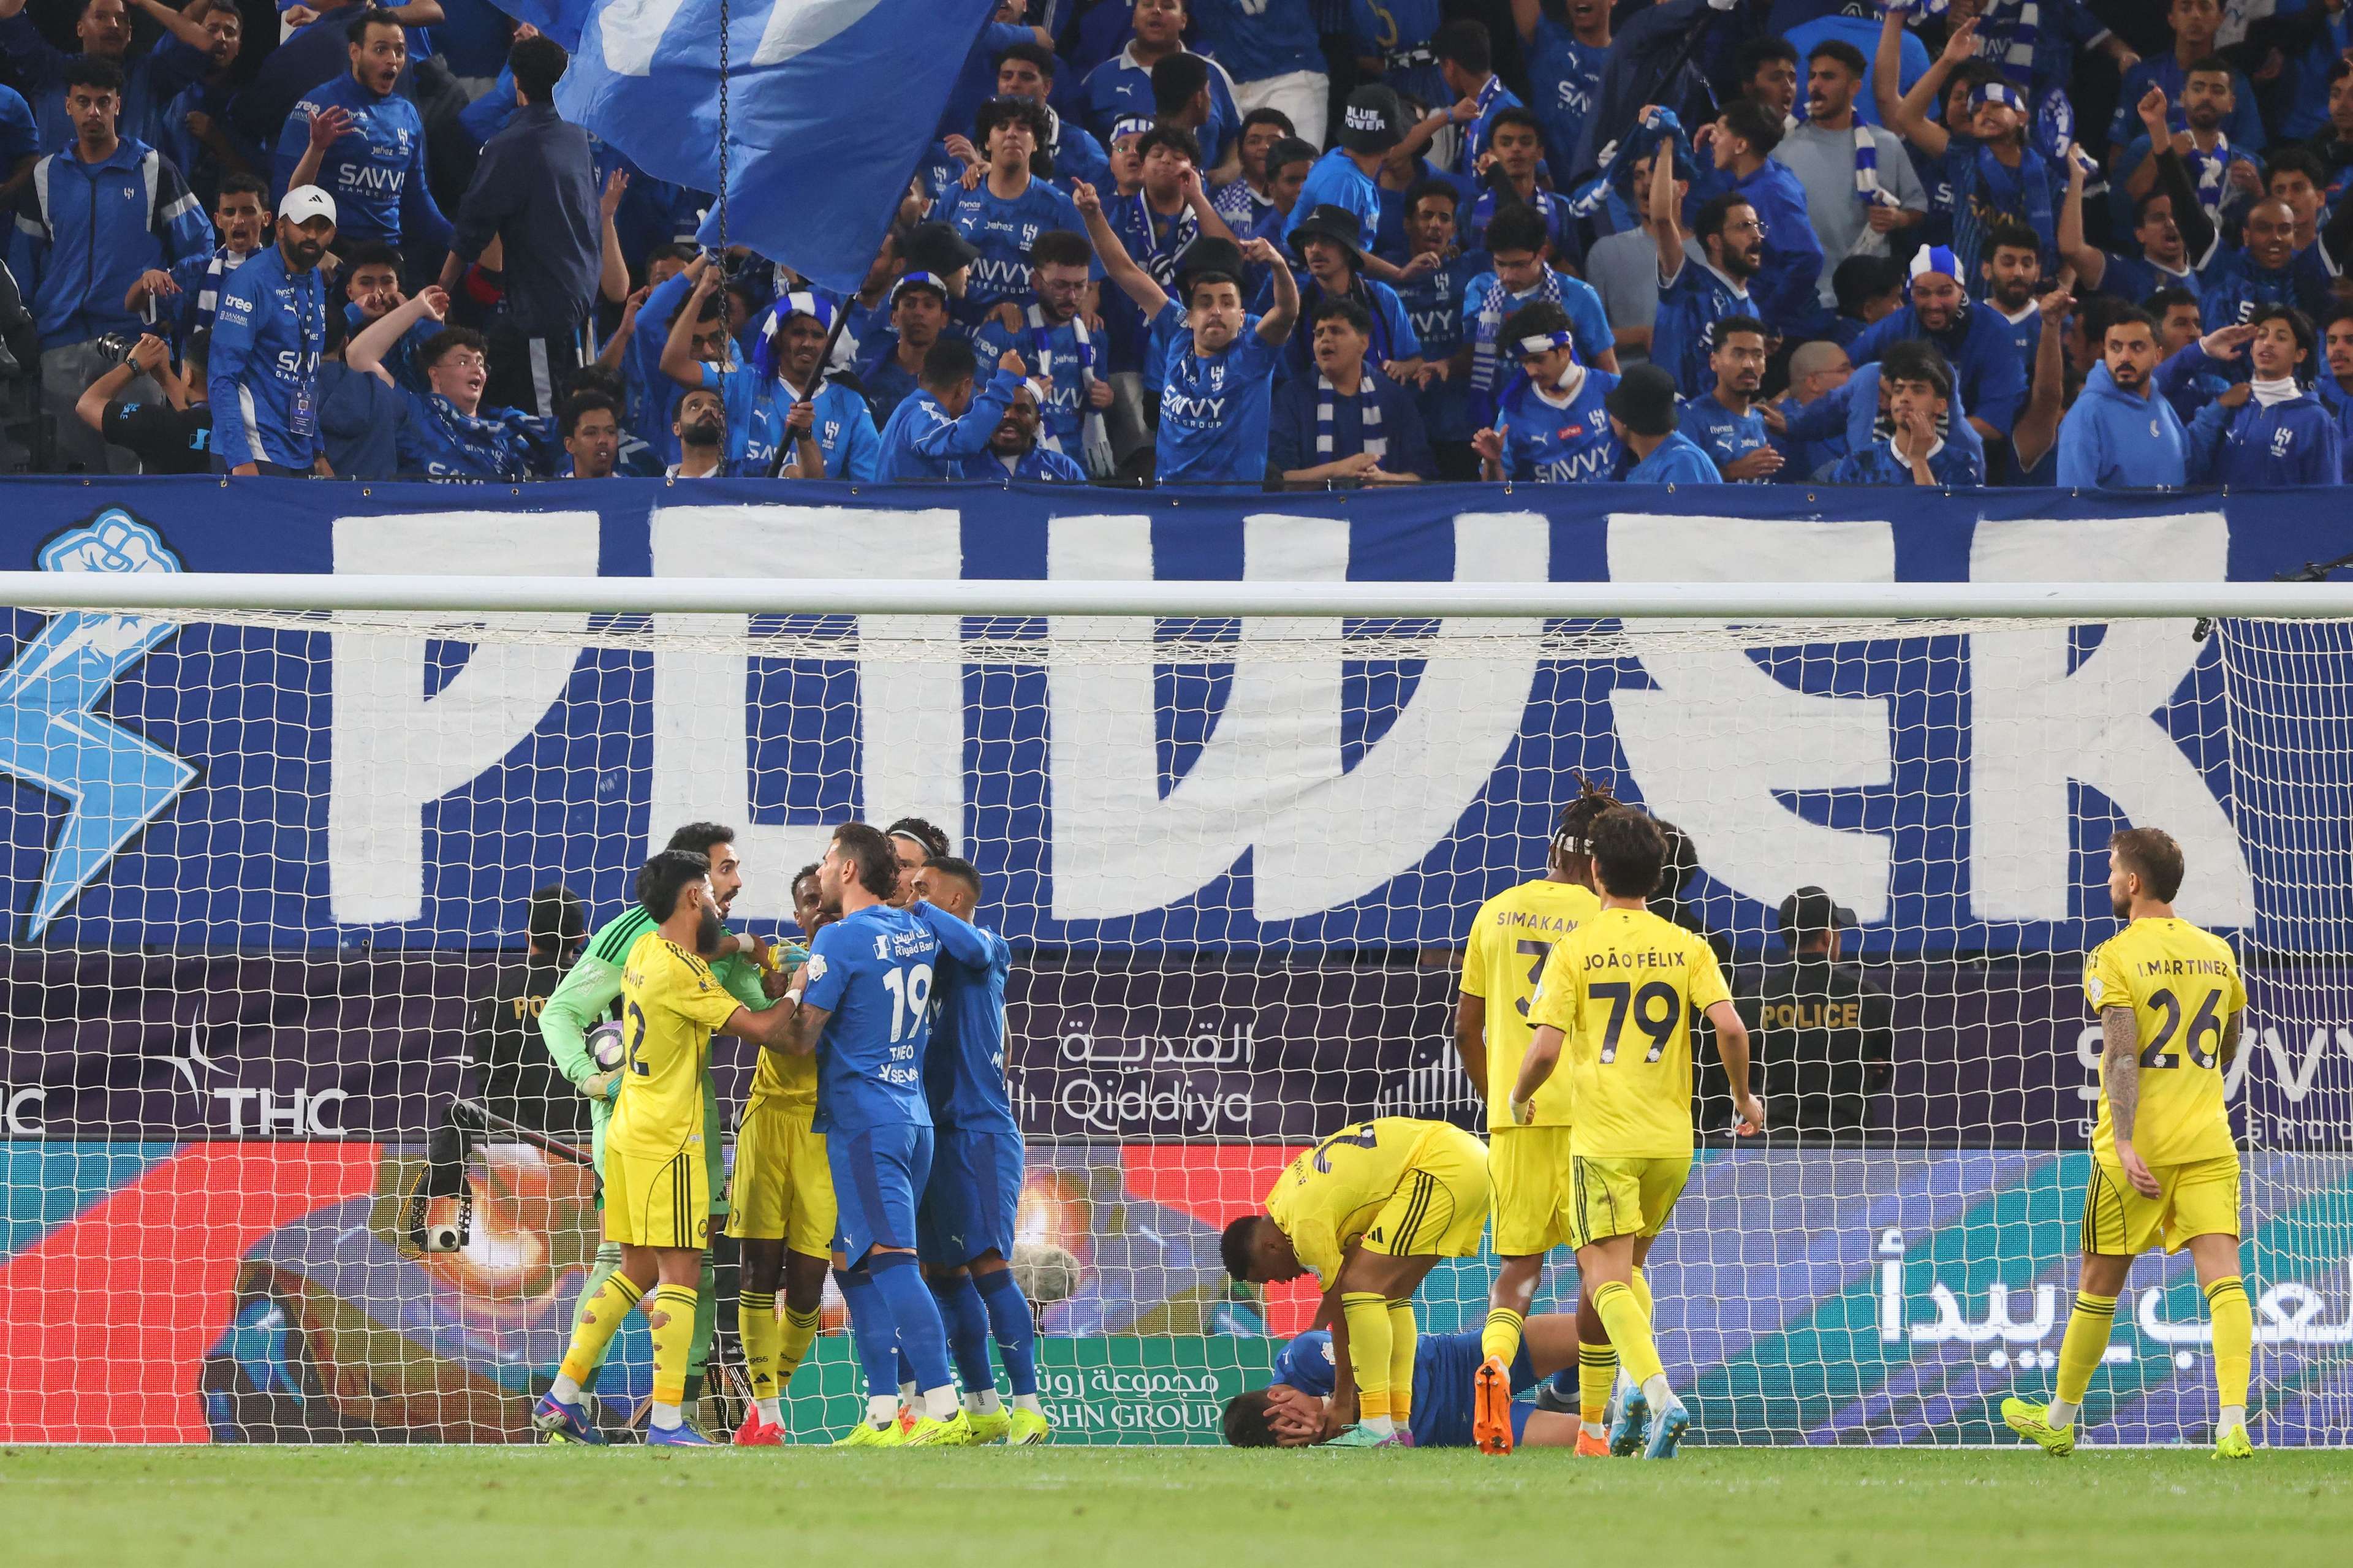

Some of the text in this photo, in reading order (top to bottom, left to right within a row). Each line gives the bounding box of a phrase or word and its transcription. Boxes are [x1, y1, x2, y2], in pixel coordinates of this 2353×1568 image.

[1347, 105, 1379, 121] BLUE
[971, 257, 1035, 285] AVVY
[225, 294, 252, 312] tree
[328, 504, 2256, 928] POWER
[1497, 912, 1578, 932] SIMAKAN
[895, 944, 919, 958] Riyad
[1583, 946, 1685, 971] JOÃO FÉLIX
[883, 964, 933, 1043] 19
[1762, 1003, 1859, 1029] POLICE
[1588, 982, 1680, 1064] 79
[2139, 988, 2221, 1069] 26
[214, 1088, 349, 1135] THC
[1062, 1078, 1252, 1132] Qiddiya
[1091, 1368, 1219, 1398] مجموعة
[1111, 1404, 1223, 1428] GROUP
